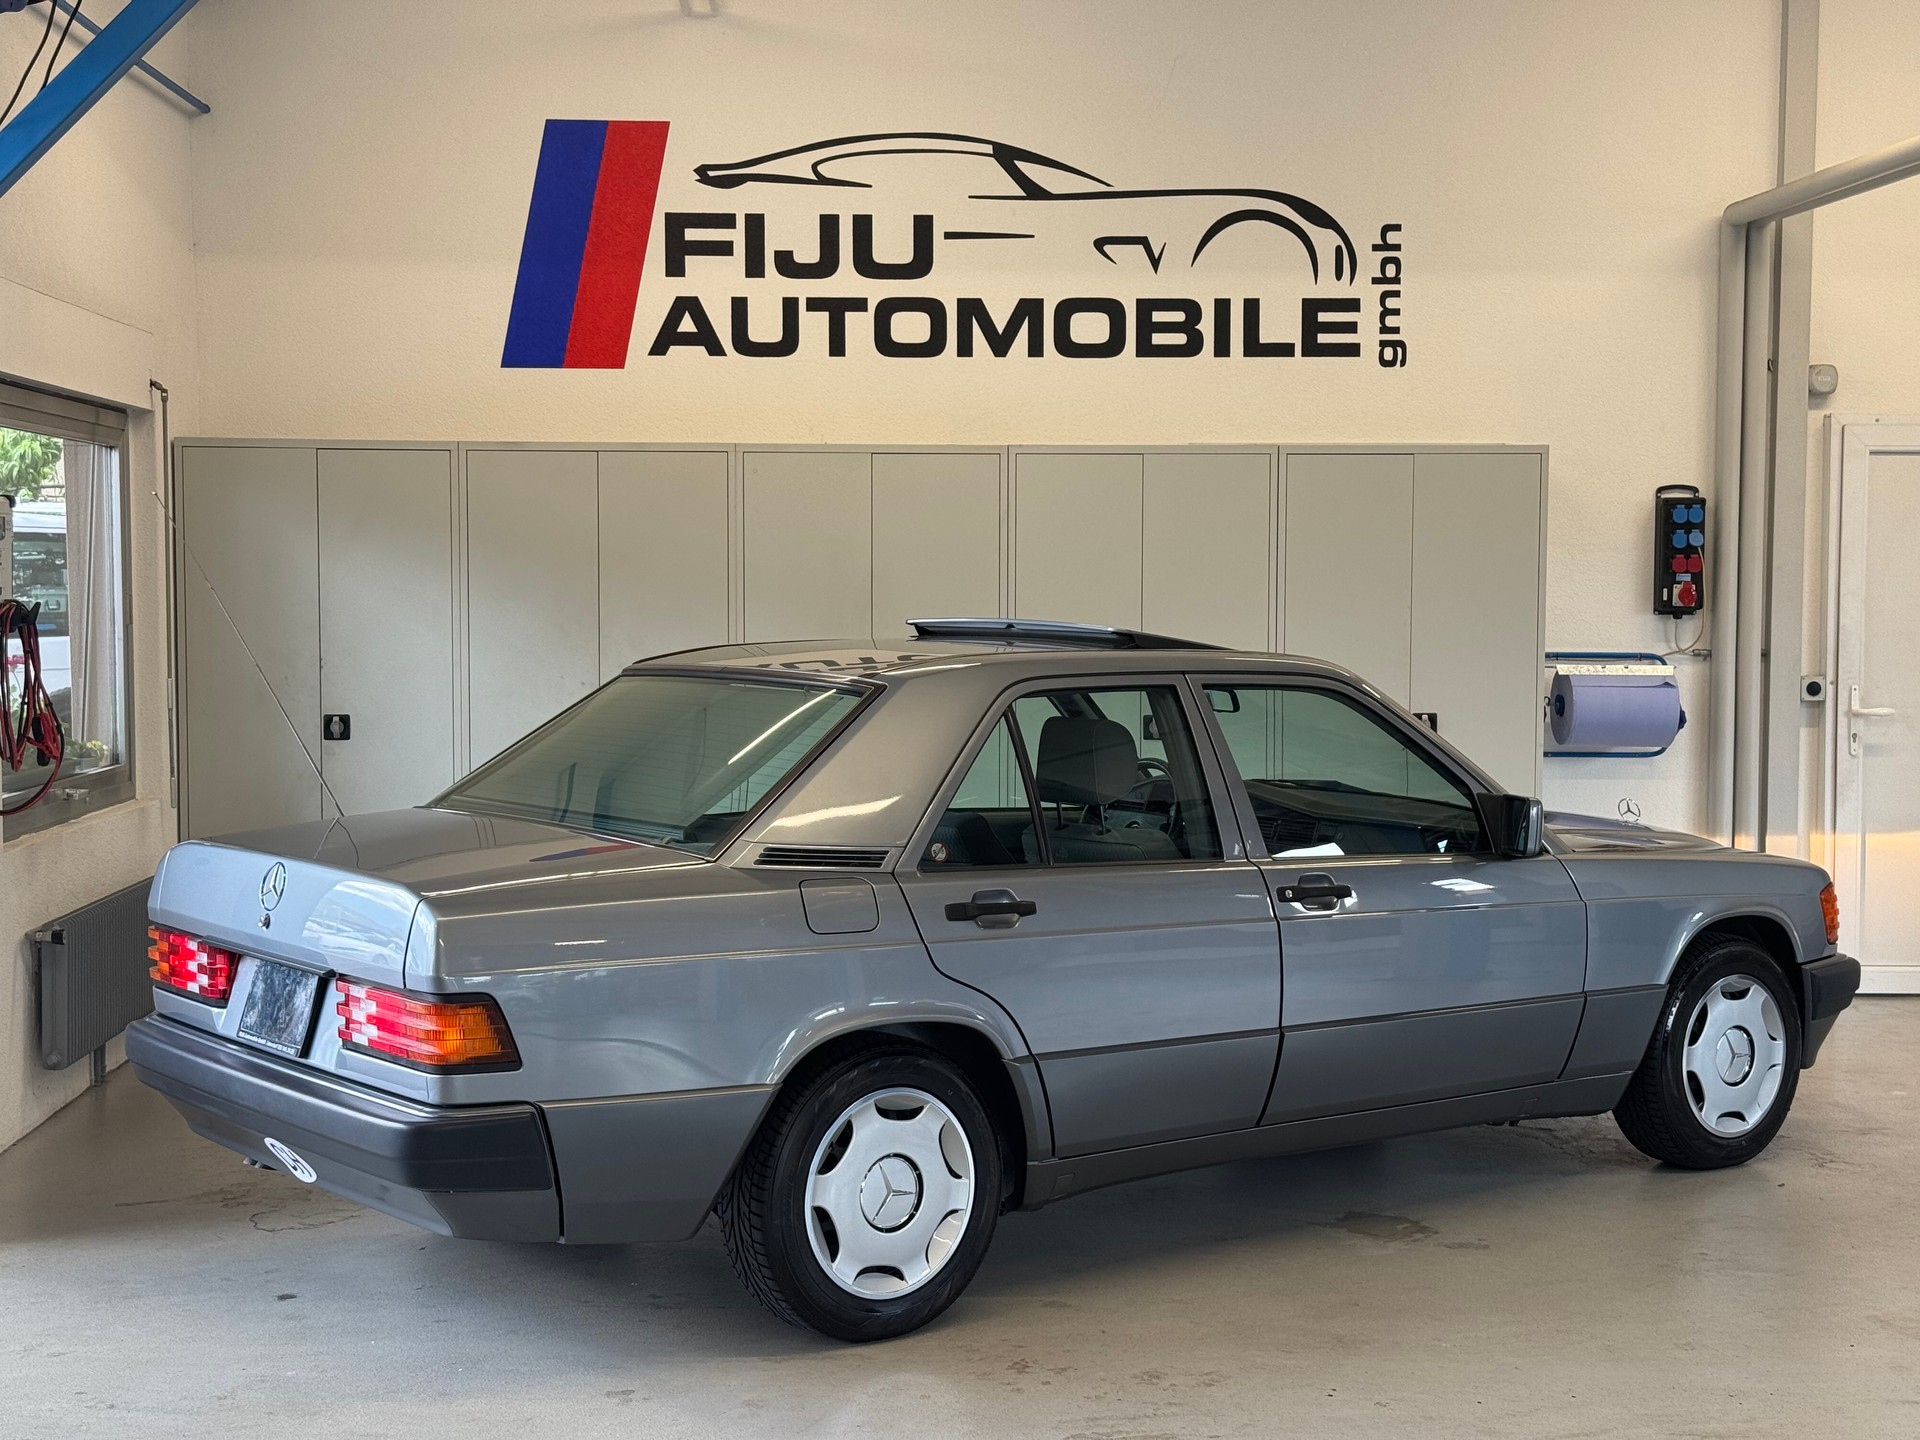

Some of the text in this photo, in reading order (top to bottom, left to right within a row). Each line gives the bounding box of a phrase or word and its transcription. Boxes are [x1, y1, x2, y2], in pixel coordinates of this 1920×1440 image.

[664, 212, 934, 280] FIJU
[647, 295, 1361, 359] AUTOMOBILE
[1371, 223, 1407, 368] gmbh
